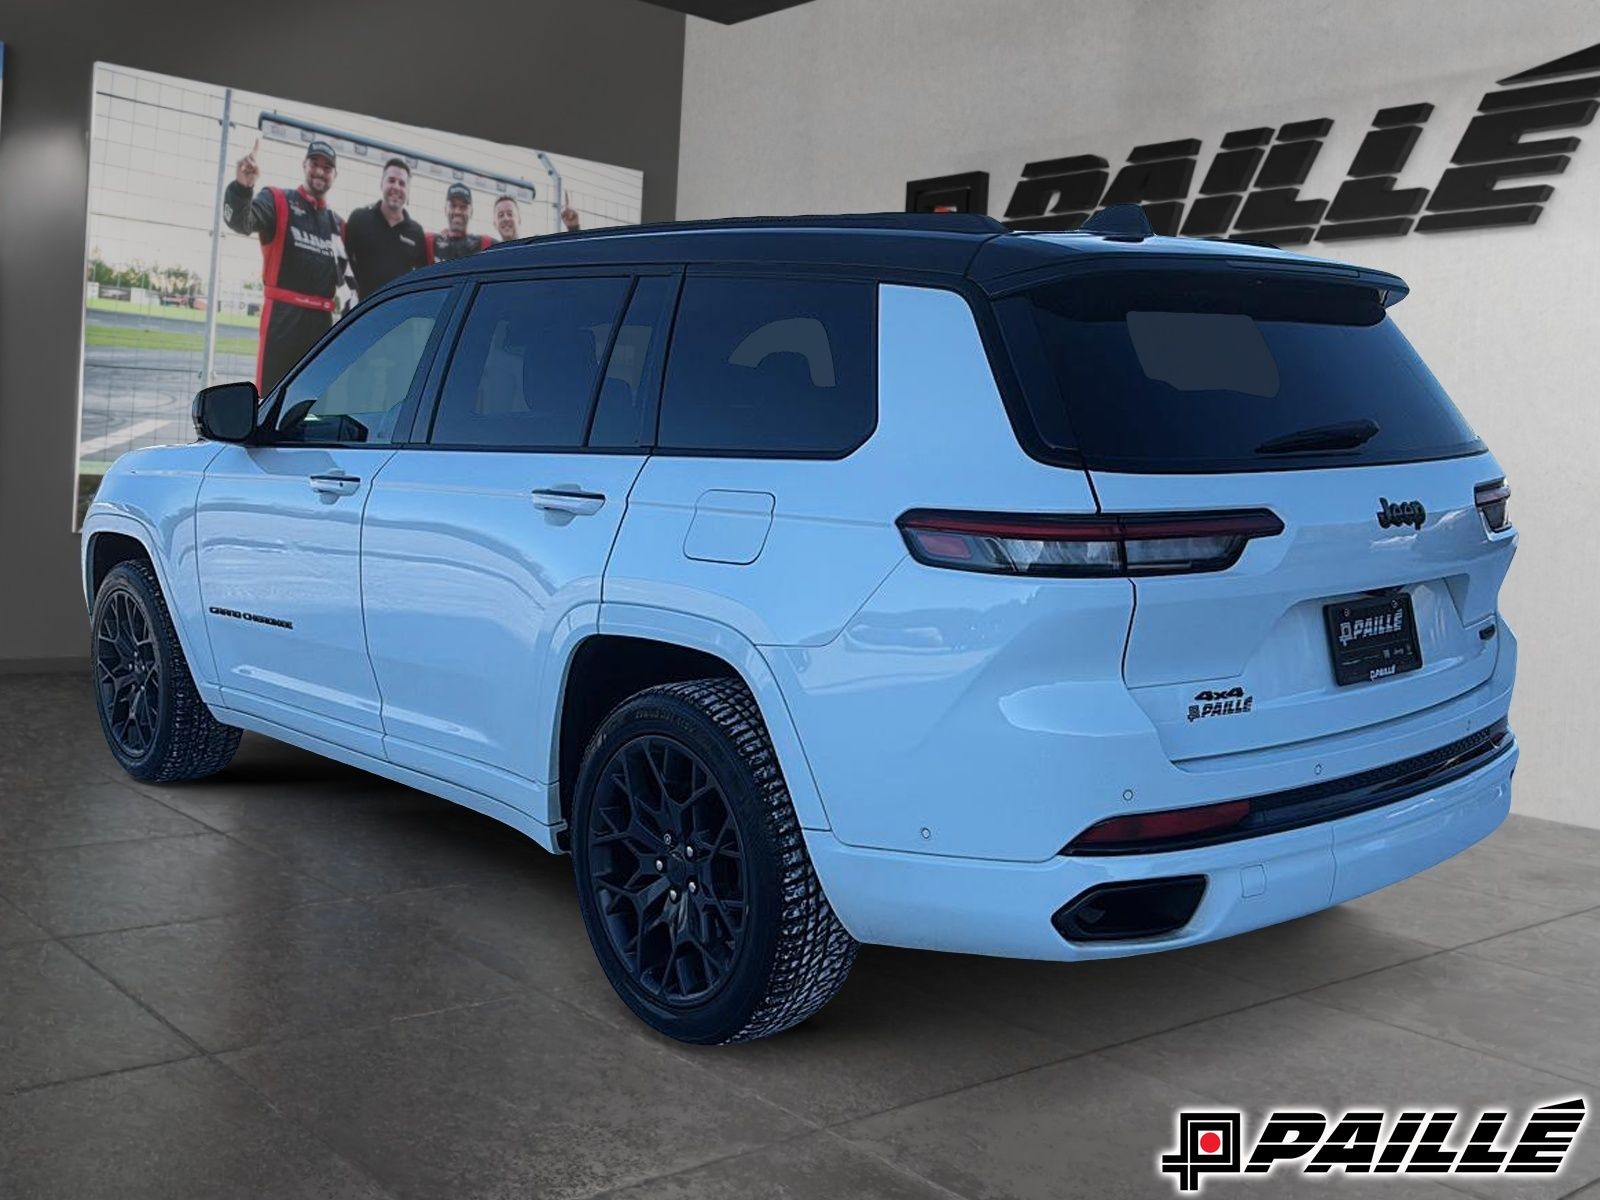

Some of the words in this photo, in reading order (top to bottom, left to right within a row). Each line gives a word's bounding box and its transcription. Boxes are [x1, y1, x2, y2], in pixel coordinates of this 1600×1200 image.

[1376, 496, 1426, 531] Jeep
[208, 606, 242, 619] GRAND
[243, 612, 294, 630] CHEROKEE
[1194, 687, 1245, 701] 4x4
